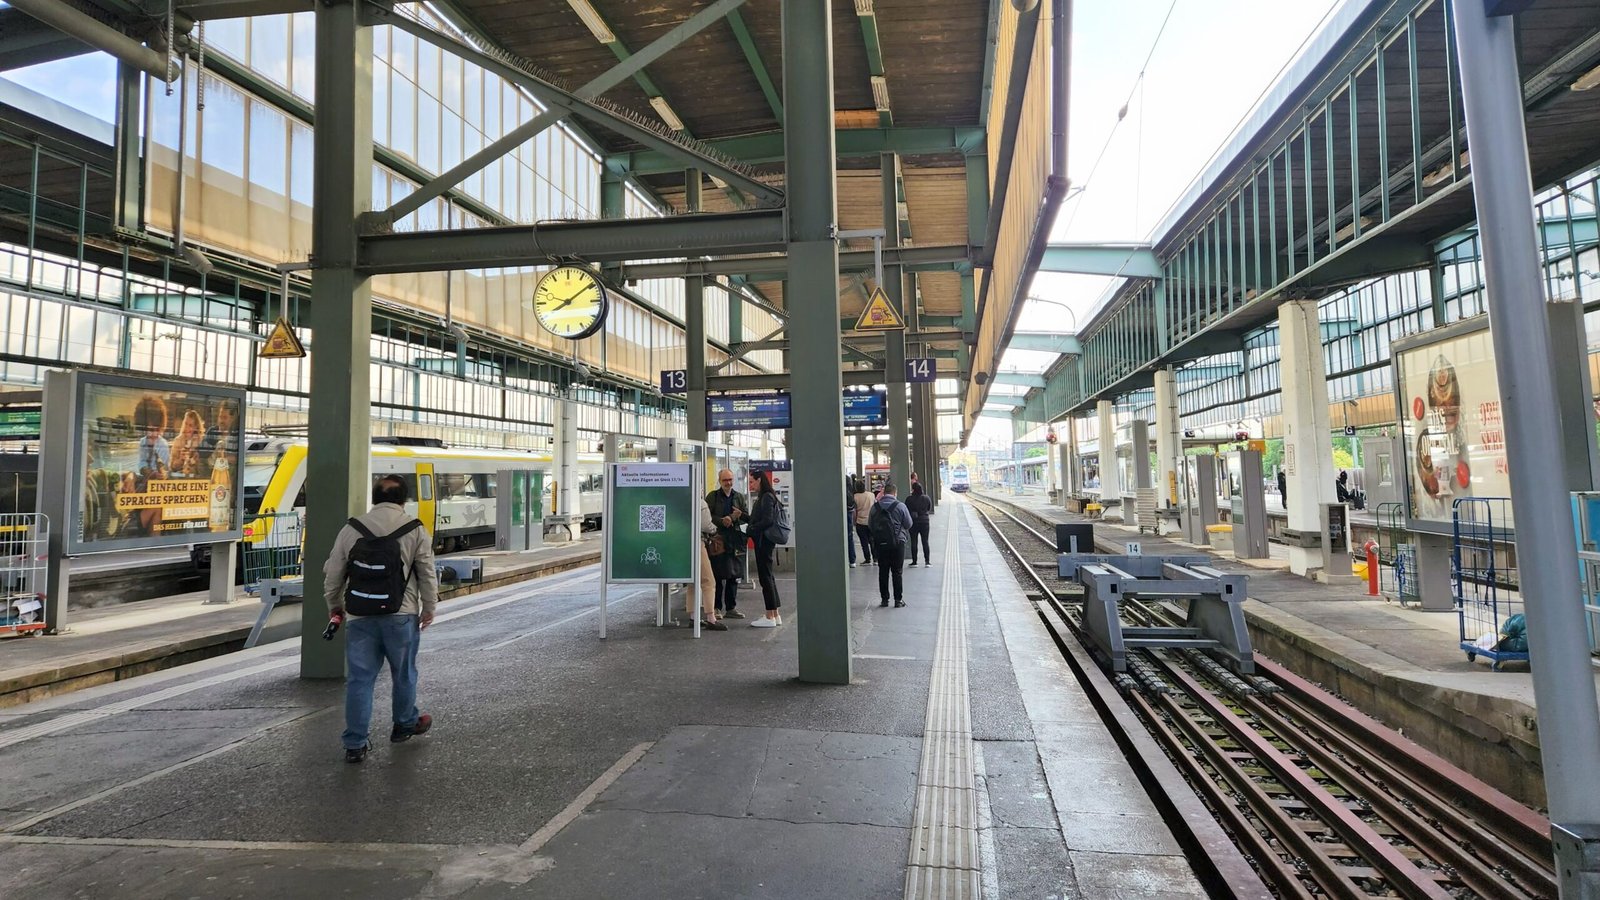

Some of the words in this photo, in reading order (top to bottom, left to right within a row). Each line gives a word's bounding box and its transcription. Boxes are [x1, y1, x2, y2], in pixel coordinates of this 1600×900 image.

[909, 359, 930, 378] 14
[666, 370, 686, 389] 13
[1345, 426, 1353, 434] G
[150, 482, 188, 492] EINFACH
[189, 482, 209, 491] EINE
[120, 495, 161, 506] SPRACHE
[163, 494, 208, 505] SPRECHEN:
[1128, 544, 1138, 553] 14
